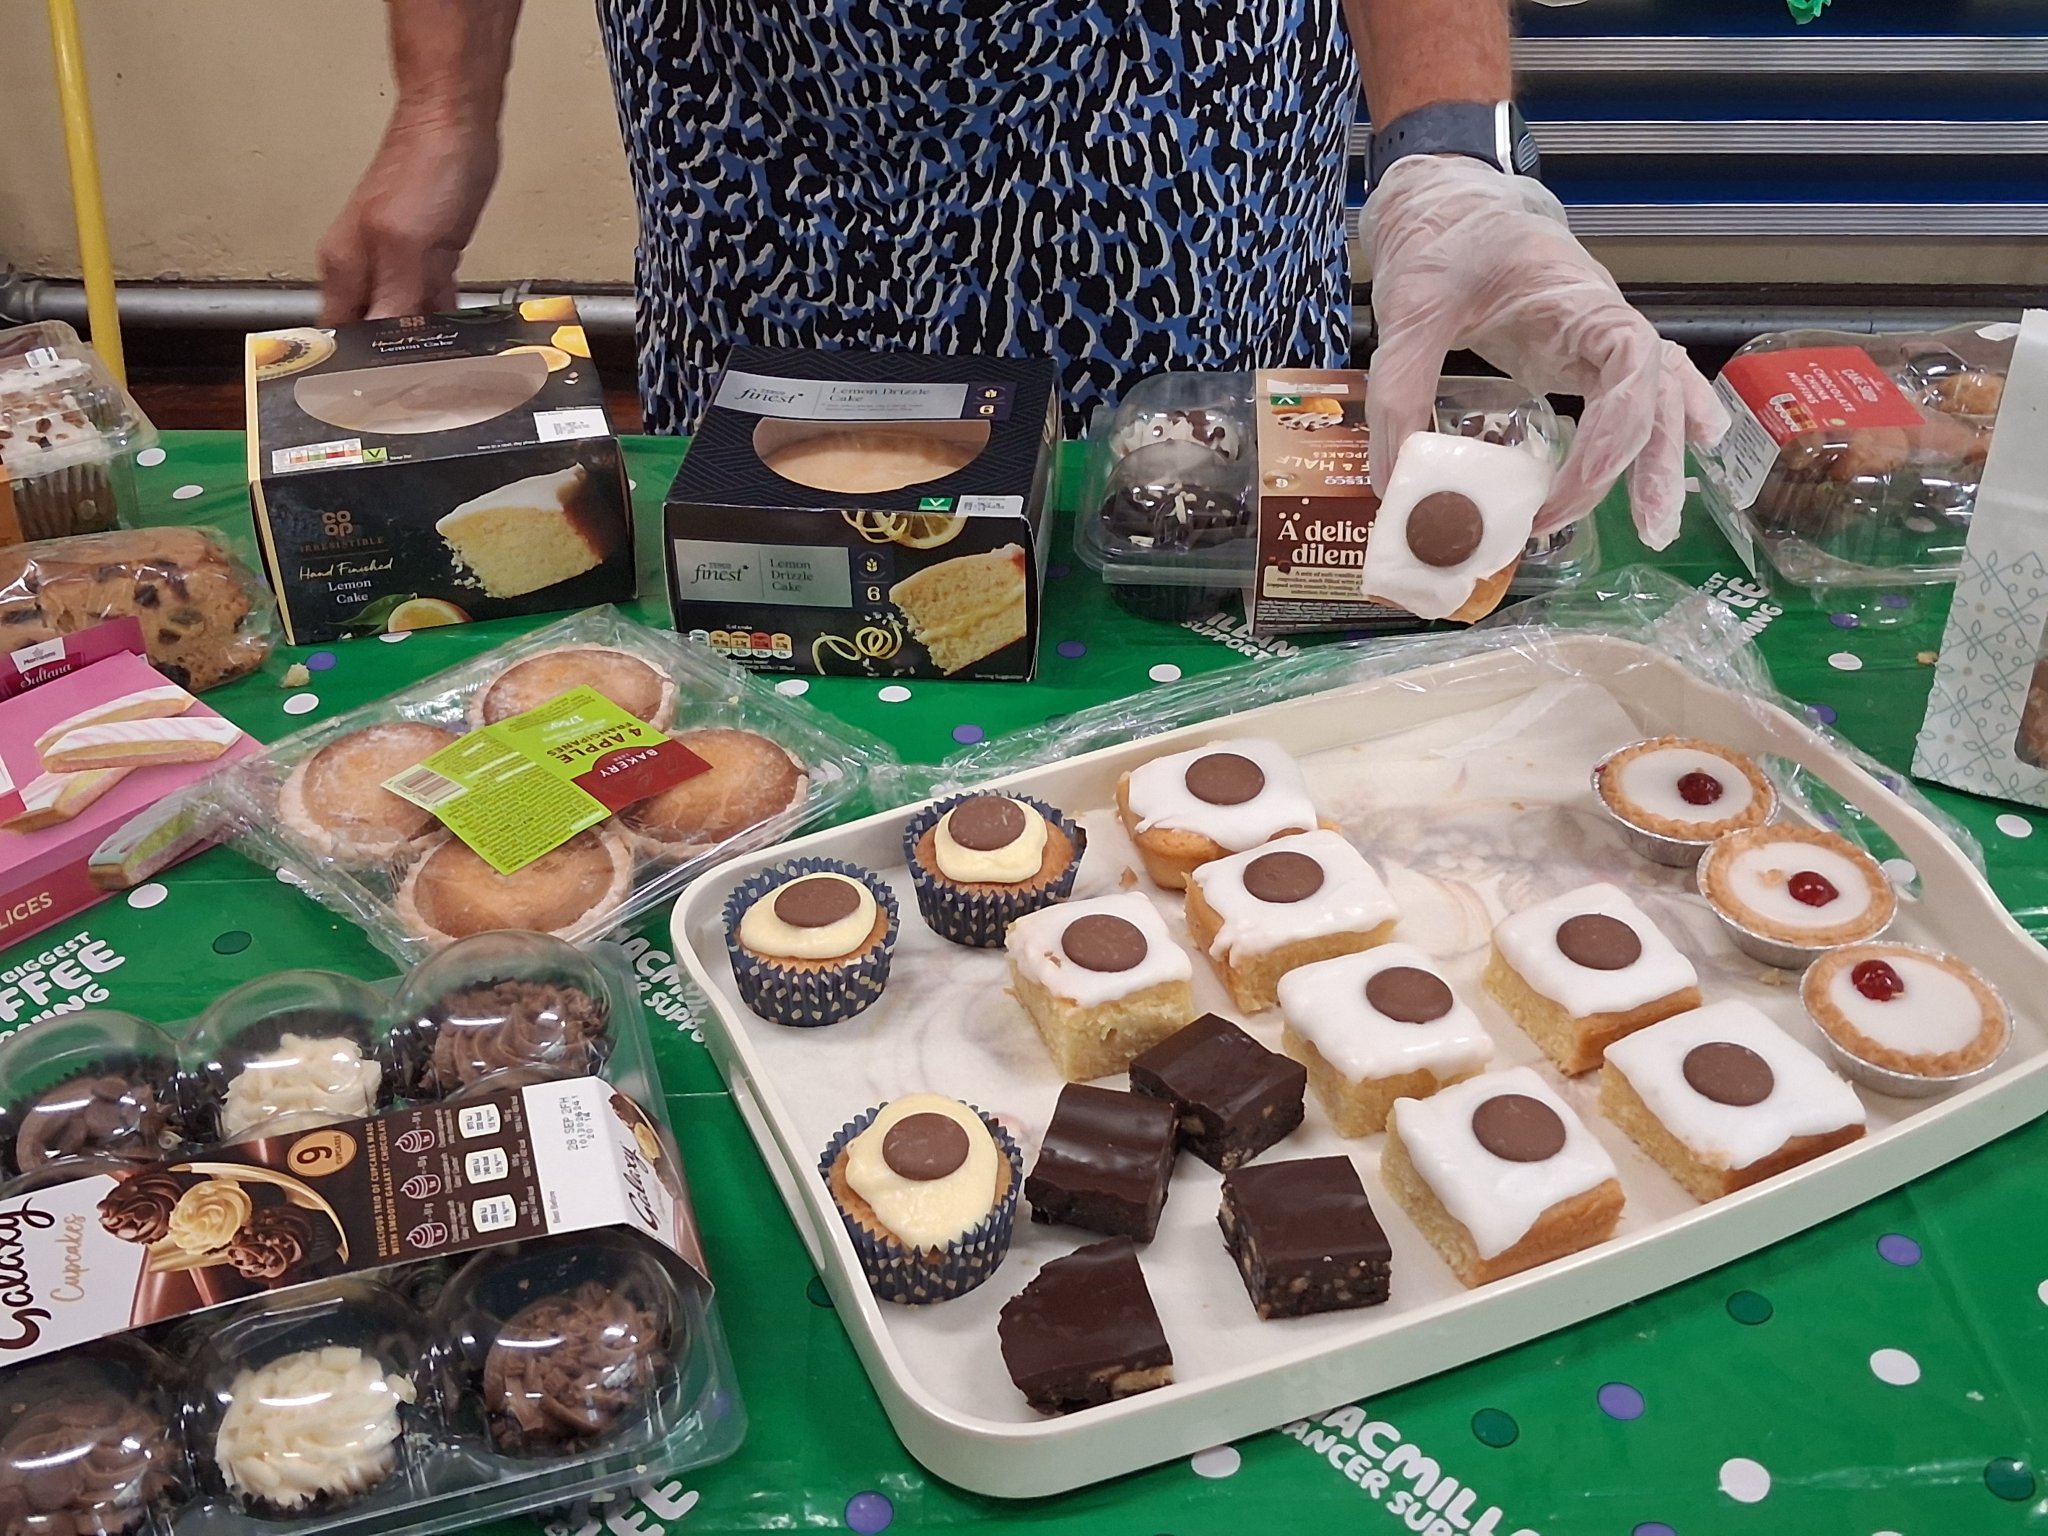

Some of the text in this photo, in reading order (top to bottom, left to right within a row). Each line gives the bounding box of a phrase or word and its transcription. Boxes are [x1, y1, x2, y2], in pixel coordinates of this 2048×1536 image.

[1785, 371, 1820, 404] MUFFINS
[1803, 374, 1832, 400] CHUNK
[1813, 367, 1857, 413] CHOCOLATE
[1275, 455, 1335, 472] HALF
[1312, 451, 1369, 459] UPCAKES
[1324, 475, 1372, 486] TESCO
[1305, 520, 1374, 543] delici
[769, 558, 812, 570] Lemon
[1291, 543, 1365, 566] dilem
[299, 563, 334, 581] Hand
[690, 563, 744, 585] finest
[771, 570, 814, 582] Drizzle
[328, 579, 372, 592] Lemon
[772, 581, 802, 592] Cake
[866, 586, 881, 601] 6
[336, 592, 369, 604] Cake
[20, 663, 73, 689] Sultana
[546, 721, 634, 757] FRANGIPANES
[628, 727, 642, 737] 4
[555, 732, 626, 764] APPLE
[600, 748, 658, 778] BAKERY
[0, 931, 92, 984] BIGGEST
[0, 939, 126, 1023] FFEE
[643, 991, 706, 1043] SUPPO
[562, 1117, 575, 1135] SEP
[377, 1119, 390, 1162] CHOCOLATE
[566, 1138, 579, 1151] 28
[367, 1144, 379, 1182] CUPCAKES
[371, 1183, 381, 1195] OF
[622, 1144, 660, 1231] Galaxy
[373, 1196, 383, 1214] TRIO
[386, 1198, 399, 1233] SMOOTH
[374, 1215, 388, 1257] DELICIOUS
[390, 1233, 400, 1256] WITH
[50, 1213, 90, 1302] Cupcakes
[1281, 1420, 1390, 1500] ANCER
[1314, 1405, 1541, 1536] ACMILL
